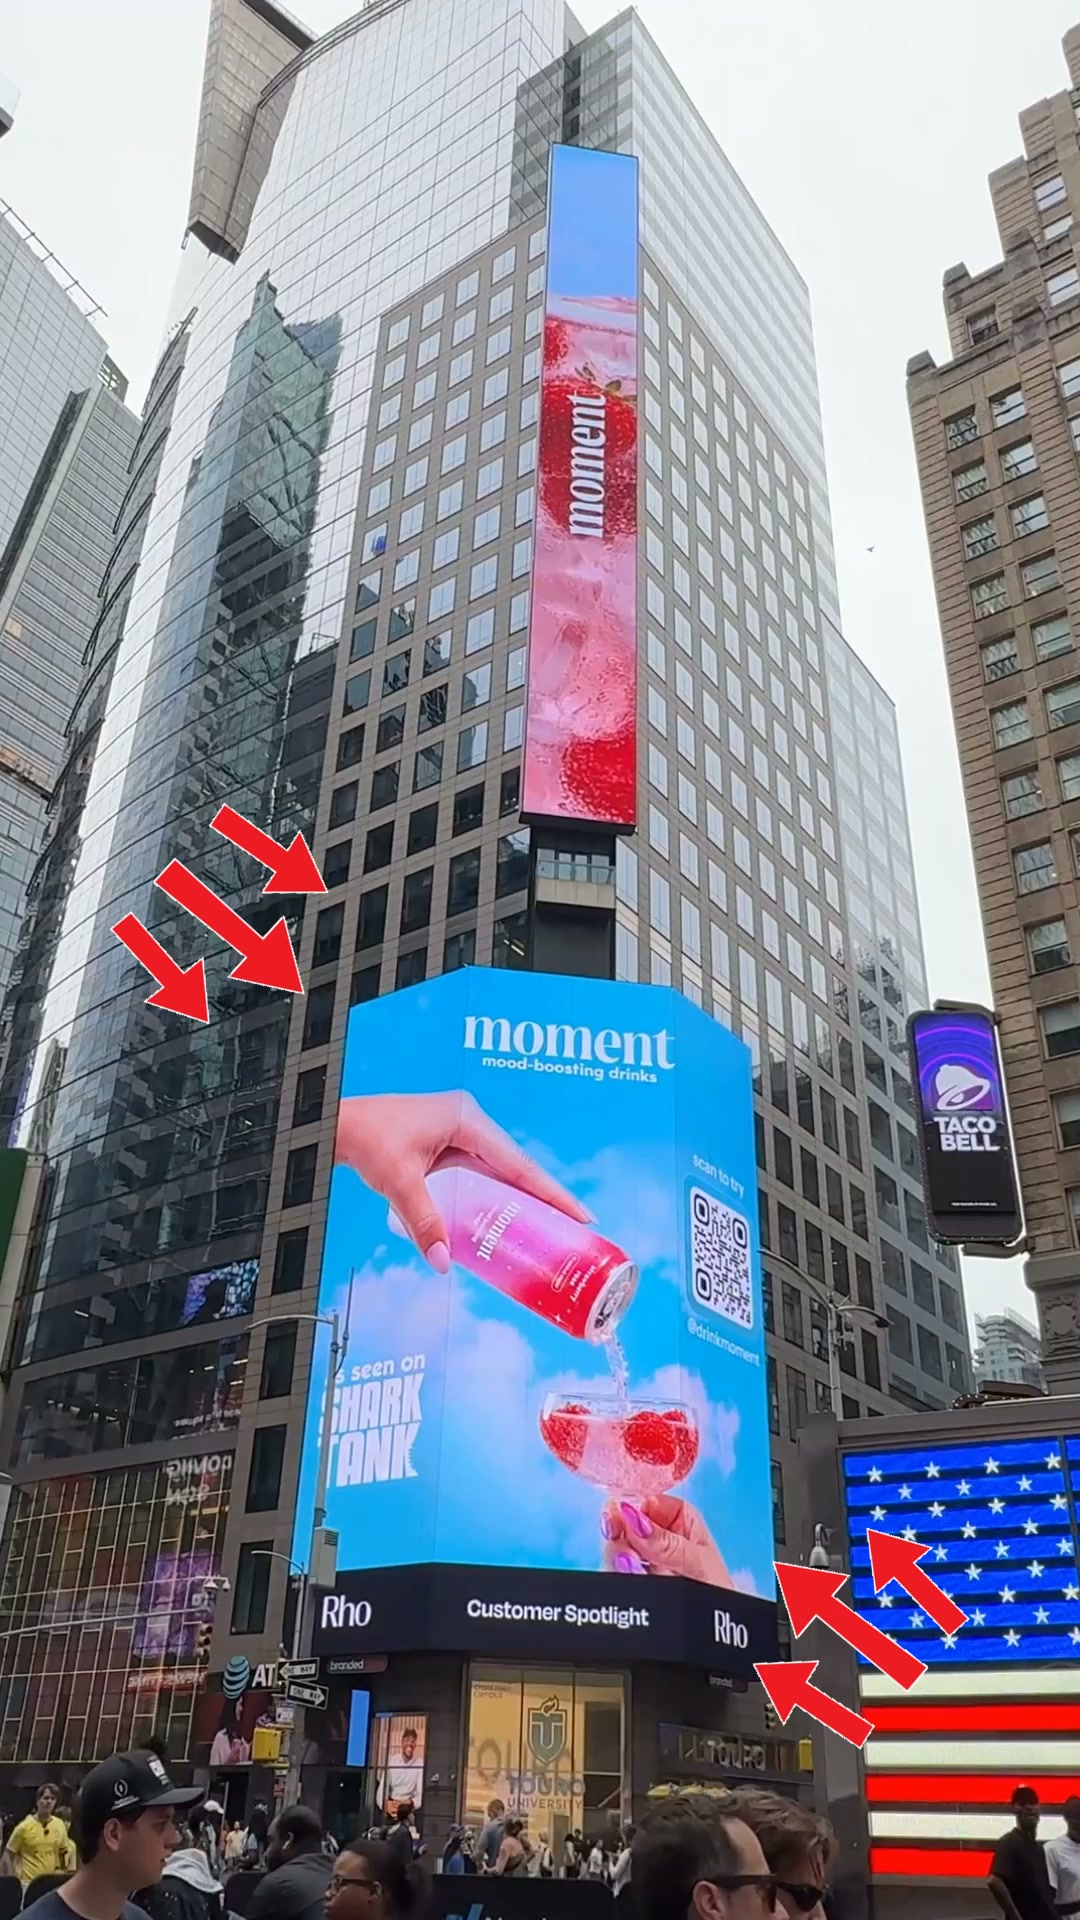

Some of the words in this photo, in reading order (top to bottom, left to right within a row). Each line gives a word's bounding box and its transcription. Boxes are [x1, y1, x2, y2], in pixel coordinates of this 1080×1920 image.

[567, 390, 606, 538] moment
[463, 1015, 676, 1070] moment
[482, 1056, 604, 1081] mood-boosting
[608, 1067, 658, 1083] drinks
[933, 1116, 997, 1134] TACO
[940, 1134, 1001, 1152] BELL
[692, 1154, 717, 1180] scan
[718, 1171, 729, 1187] to
[730, 1179, 745, 1199] try
[476, 1201, 522, 1263] moment
[687, 1317, 762, 1367] @drinkmoment
[351, 1359, 395, 1382] seen
[401, 1353, 426, 1372] on
[319, 1373, 425, 1434] SHARK
[321, 1594, 372, 1628] Rho
[467, 1598, 562, 1621] Customer
[564, 1603, 650, 1629] Spotlight
[714, 1609, 749, 1649] Rho
[330, 1658, 365, 1671] branded
[506, 1774, 586, 1797] TOURO
[507, 1798, 583, 1809] UNIVERSIY
